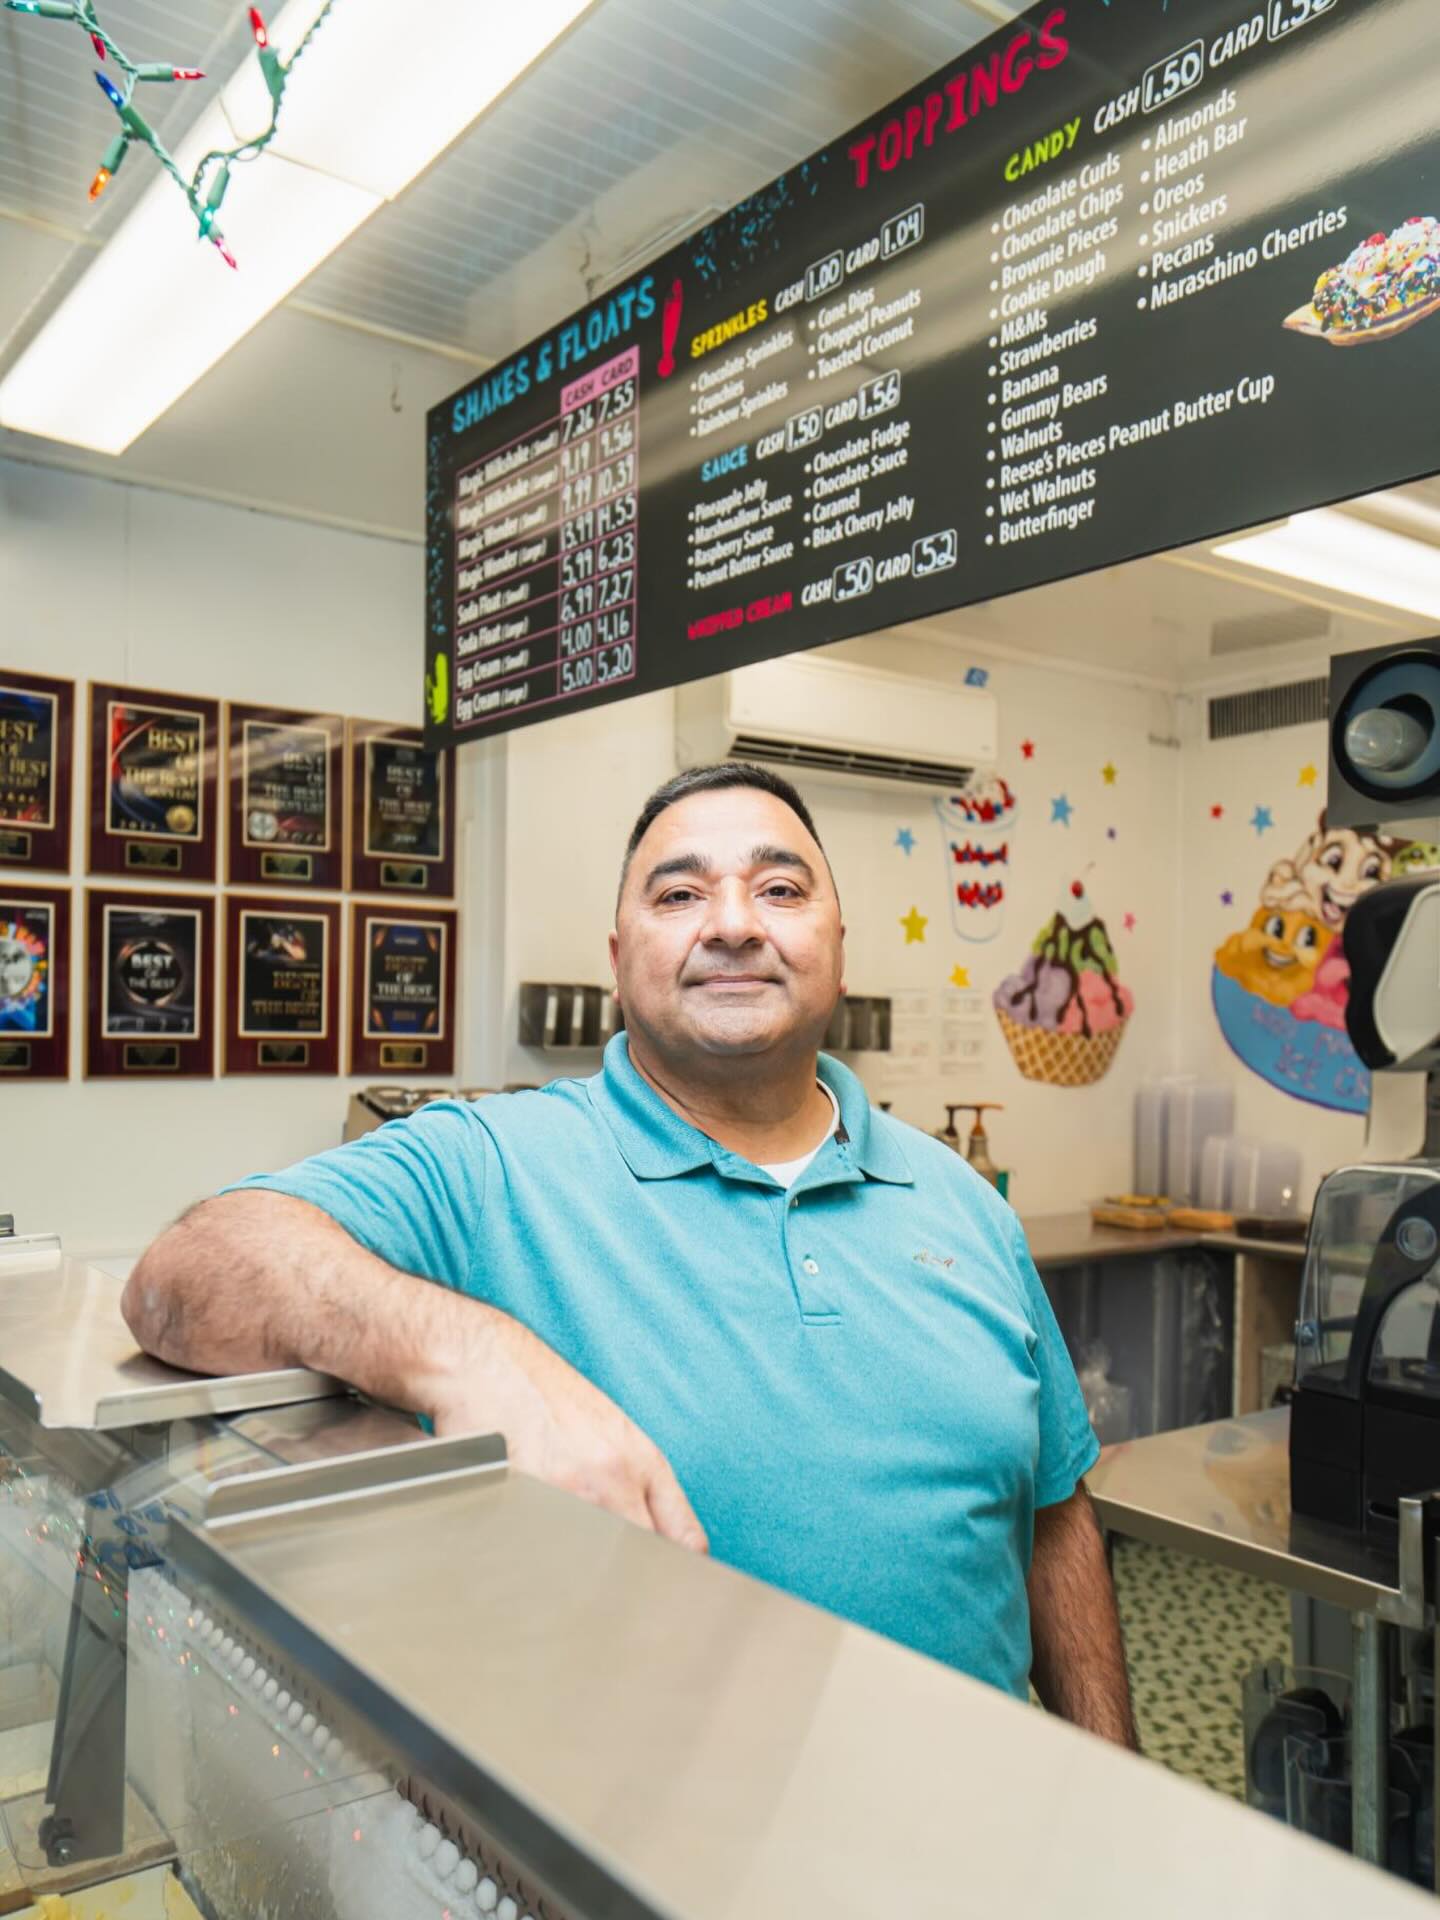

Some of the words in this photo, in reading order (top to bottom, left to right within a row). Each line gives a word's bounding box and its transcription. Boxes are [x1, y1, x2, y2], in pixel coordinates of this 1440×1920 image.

[848, 8, 1069, 188] TOPPINGS
[1005, 117, 1080, 182] CANDY
[1094, 86, 1140, 133] CASH
[1145, 52, 1200, 106] 1.50
[1209, 15, 1264, 68] CARD
[1155, 88, 1237, 152] Almonds
[1154, 137, 1209, 182] Heath
[1214, 118, 1248, 152] Bar
[1002, 177, 1077, 232] Chocolate
[1079, 152, 1121, 190] Curls
[1153, 172, 1205, 214] Oreos
[1001, 207, 1077, 260] Chocolate
[1079, 183, 1124, 221] Chips
[1152, 194, 1228, 247] Snickers
[1001, 243, 1065, 289] Brownie
[1067, 217, 1118, 257] Pieces
[1150, 246, 1258, 310] Maraschino
[1262, 205, 1348, 260] Cherries
[1152, 232, 1215, 278] Pecans
[690, 299, 768, 358] SPRINKLES
[774, 279, 805, 313] CASH
[808, 258, 840, 297] 1.00
[846, 238, 880, 274] CARD
[884, 212, 920, 255] 1.04
[817, 301, 847, 330] Cone
[848, 287, 875, 314] Dips
[1001, 277, 1050, 317] Cookie
[1053, 250, 1106, 293] Dough
[817, 314, 868, 354] Chopped
[871, 289, 921, 326] Peanuts
[999, 317, 1097, 375] Strawberries
[1000, 308, 1048, 347] M&Ms
[452, 356, 530, 433] SHAKES
[536, 342, 553, 383] &
[559, 276, 656, 370] FLOATS
[601, 357, 634, 386] CARD
[818, 343, 862, 380] Toasted
[864, 317, 914, 357] Coconut
[599, 380, 634, 424] 7.55
[1001, 393, 1060, 431] Gummy
[1063, 374, 1108, 409] Bears
[1002, 364, 1059, 403] Banana
[701, 444, 748, 482] SAUCE
[756, 430, 785, 460] CASH
[787, 413, 820, 449] 1.50
[824, 397, 858, 429] CARD
[859, 376, 899, 416] 1.56
[813, 437, 869, 475] Chocolate
[871, 421, 910, 451] Fudge
[1000, 449, 1054, 488] Reese's
[1057, 434, 1106, 469] Pieces
[1109, 408, 1170, 450] Peanut
[1173, 386, 1234, 427] Butter
[1237, 374, 1274, 403] Cup
[1001, 420, 1063, 459] Walnuts
[813, 464, 869, 499] Chocolate
[871, 448, 907, 477] Sauce
[1000, 489, 1030, 516] Wet
[1032, 467, 1096, 505] Walnuts
[761, 494, 792, 520] Sauce
[812, 488, 860, 523] Caramel
[812, 523, 844, 548] Black
[844, 506, 884, 537] Cherry
[885, 496, 914, 523] Jelly
[999, 498, 1096, 544] Butterfinger
[598, 532, 633, 570] 6.23
[743, 525, 774, 549] Sauce
[762, 541, 794, 566] Sauce
[598, 569, 633, 608] 7.27
[801, 579, 832, 606] CASH
[876, 553, 911, 582] CARD
[562, 622, 592, 656] 4.00
[597, 609, 630, 642] 4.16
[563, 657, 593, 692] 5.00
[598, 642, 632, 684] 5.20
[131, 954, 174, 969] BEST
